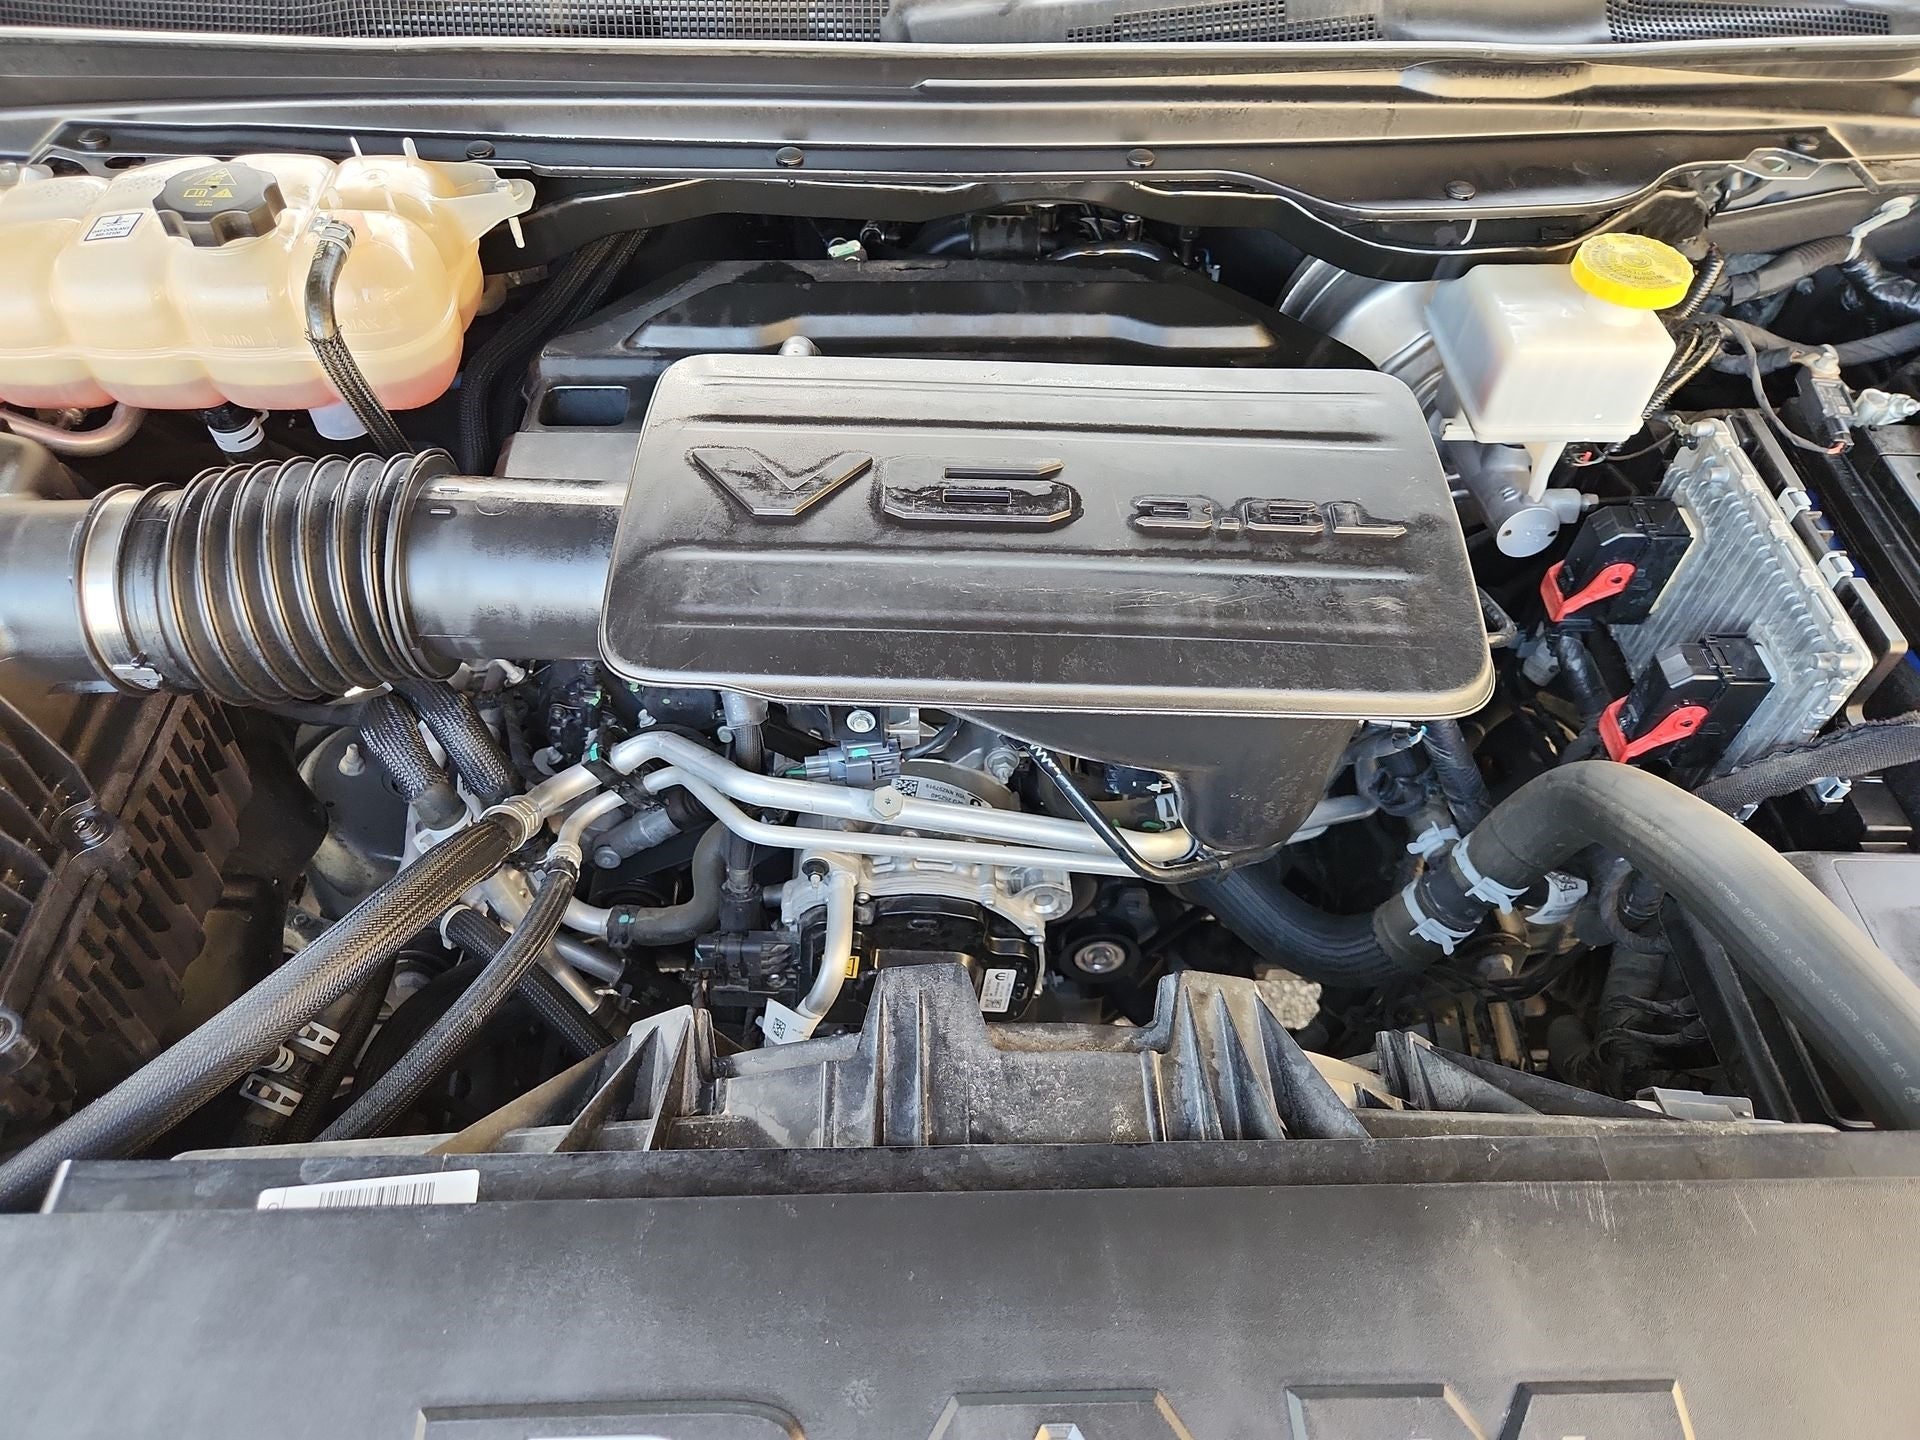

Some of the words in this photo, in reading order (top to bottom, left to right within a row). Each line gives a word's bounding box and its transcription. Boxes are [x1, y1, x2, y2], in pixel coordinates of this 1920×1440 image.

[223, 334, 255, 346] MIN
[690, 446, 1073, 523] V6
[1134, 497, 1405, 539] 3.6L
